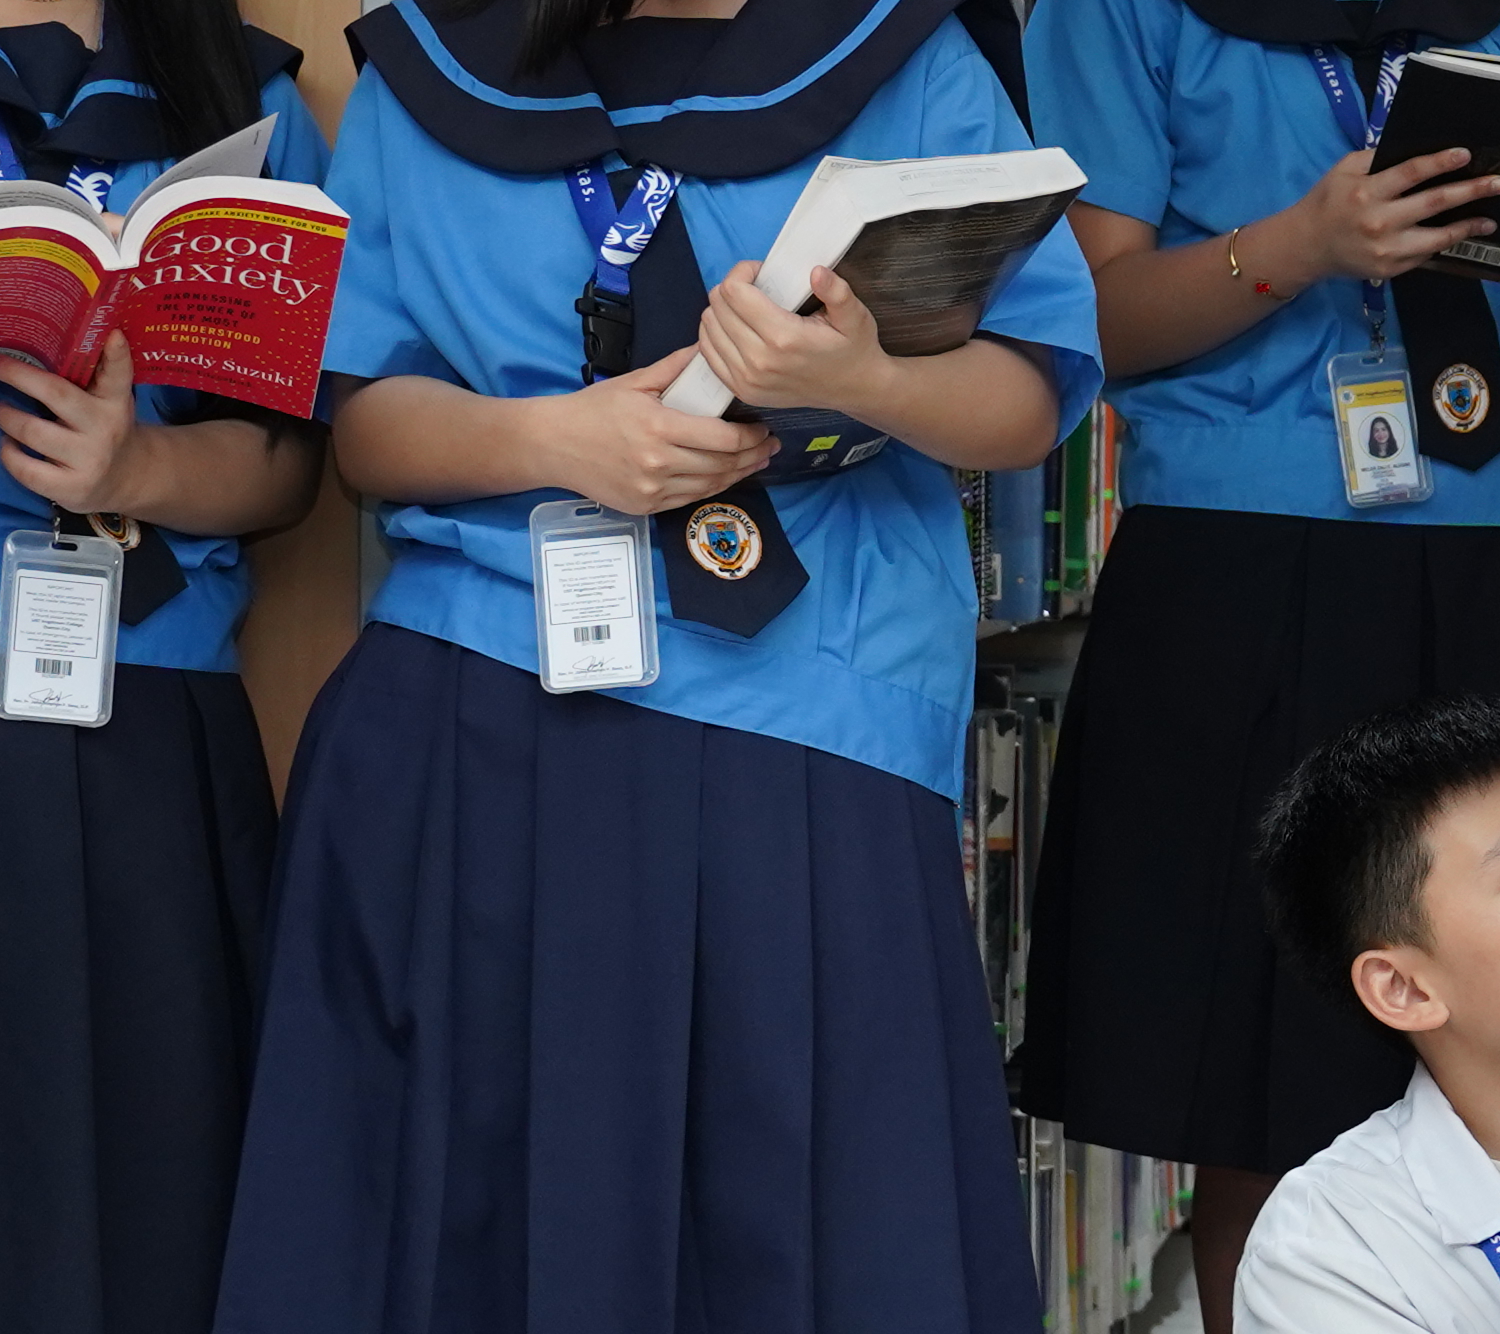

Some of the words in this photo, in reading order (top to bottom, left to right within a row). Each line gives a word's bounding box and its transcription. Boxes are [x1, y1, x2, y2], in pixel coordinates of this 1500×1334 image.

[197, 210, 221, 218] MAKE
[224, 210, 261, 220] ANXIETY
[263, 215, 288, 225] WORK
[291, 220, 308, 229] FOR
[310, 224, 328, 233] YOU
[145, 229, 293, 265] Good
[130, 257, 323, 305] Anxiety
[163, 292, 252, 308] HARNESSING
[156, 303, 180, 312] THE
[187, 304, 235, 317] POWER
[240, 310, 257, 320] OF
[171, 313, 196, 322] THE
[201, 314, 239, 328] MOST
[144, 323, 261, 345] MISUNDERSTOOD
[171, 334, 232, 349] EMOTION
[142, 350, 217, 369] Wendy
[222, 359, 295, 387] Suzuki
